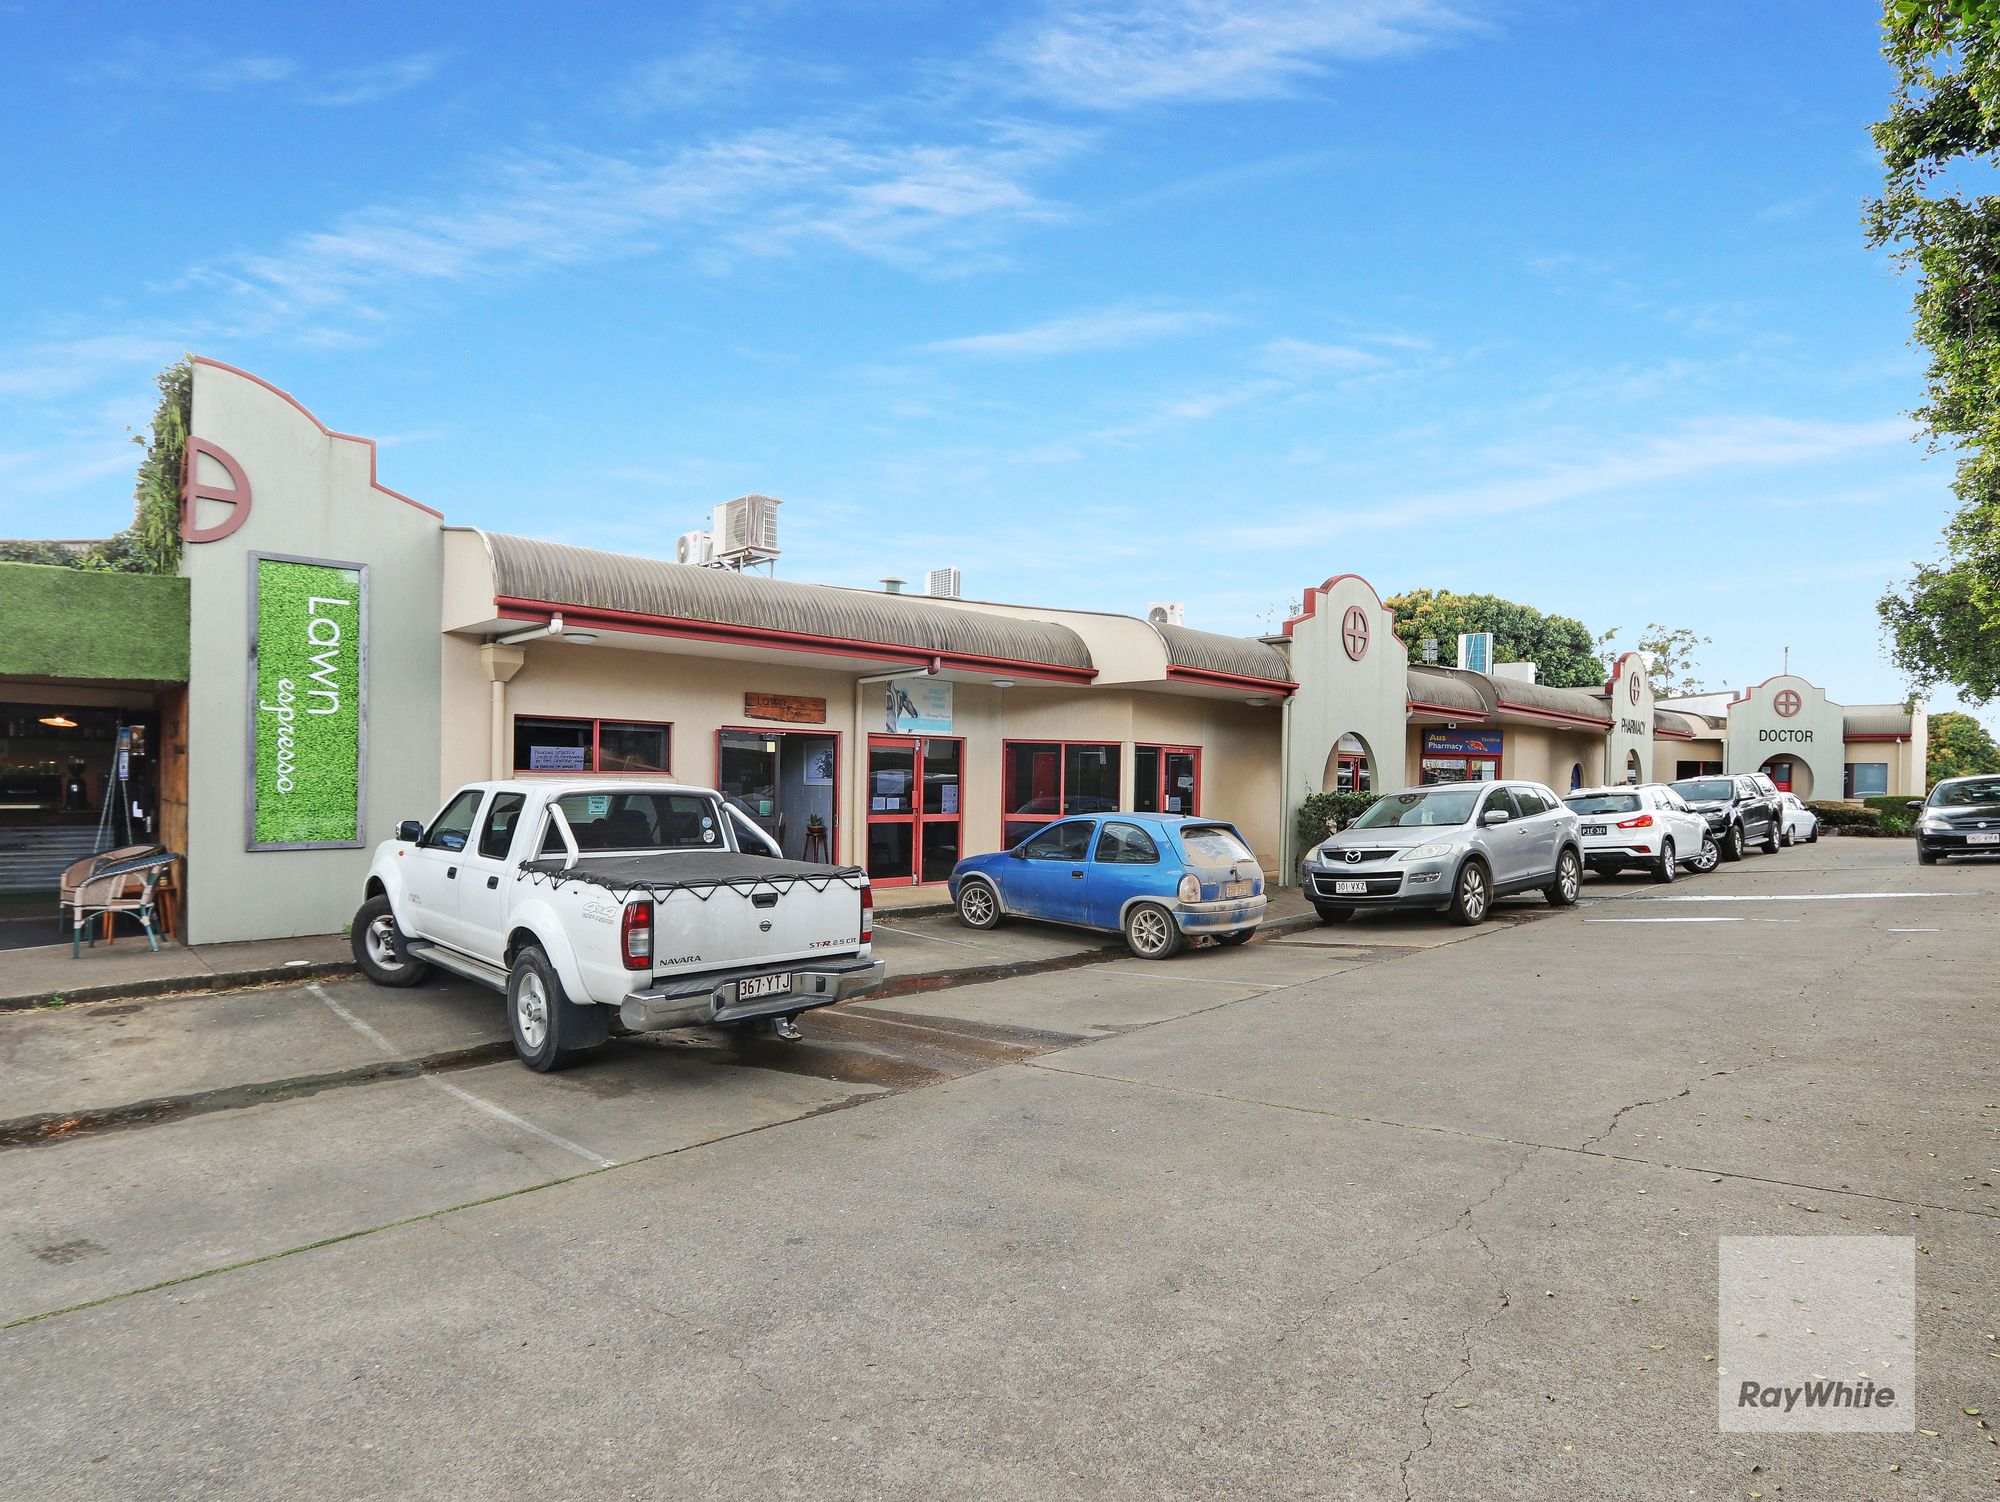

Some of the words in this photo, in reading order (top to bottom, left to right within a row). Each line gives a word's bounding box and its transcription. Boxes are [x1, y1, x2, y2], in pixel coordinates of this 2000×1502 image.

[307, 597, 351, 714] Lawn
[757, 695, 786, 707] Lawn
[1621, 718, 1646, 736] PHARMACY
[260, 678, 296, 794] espresso
[1759, 729, 1814, 743] DOCTOR
[1428, 741, 1464, 751] Pharmacy
[659, 955, 702, 966] NAVARA
